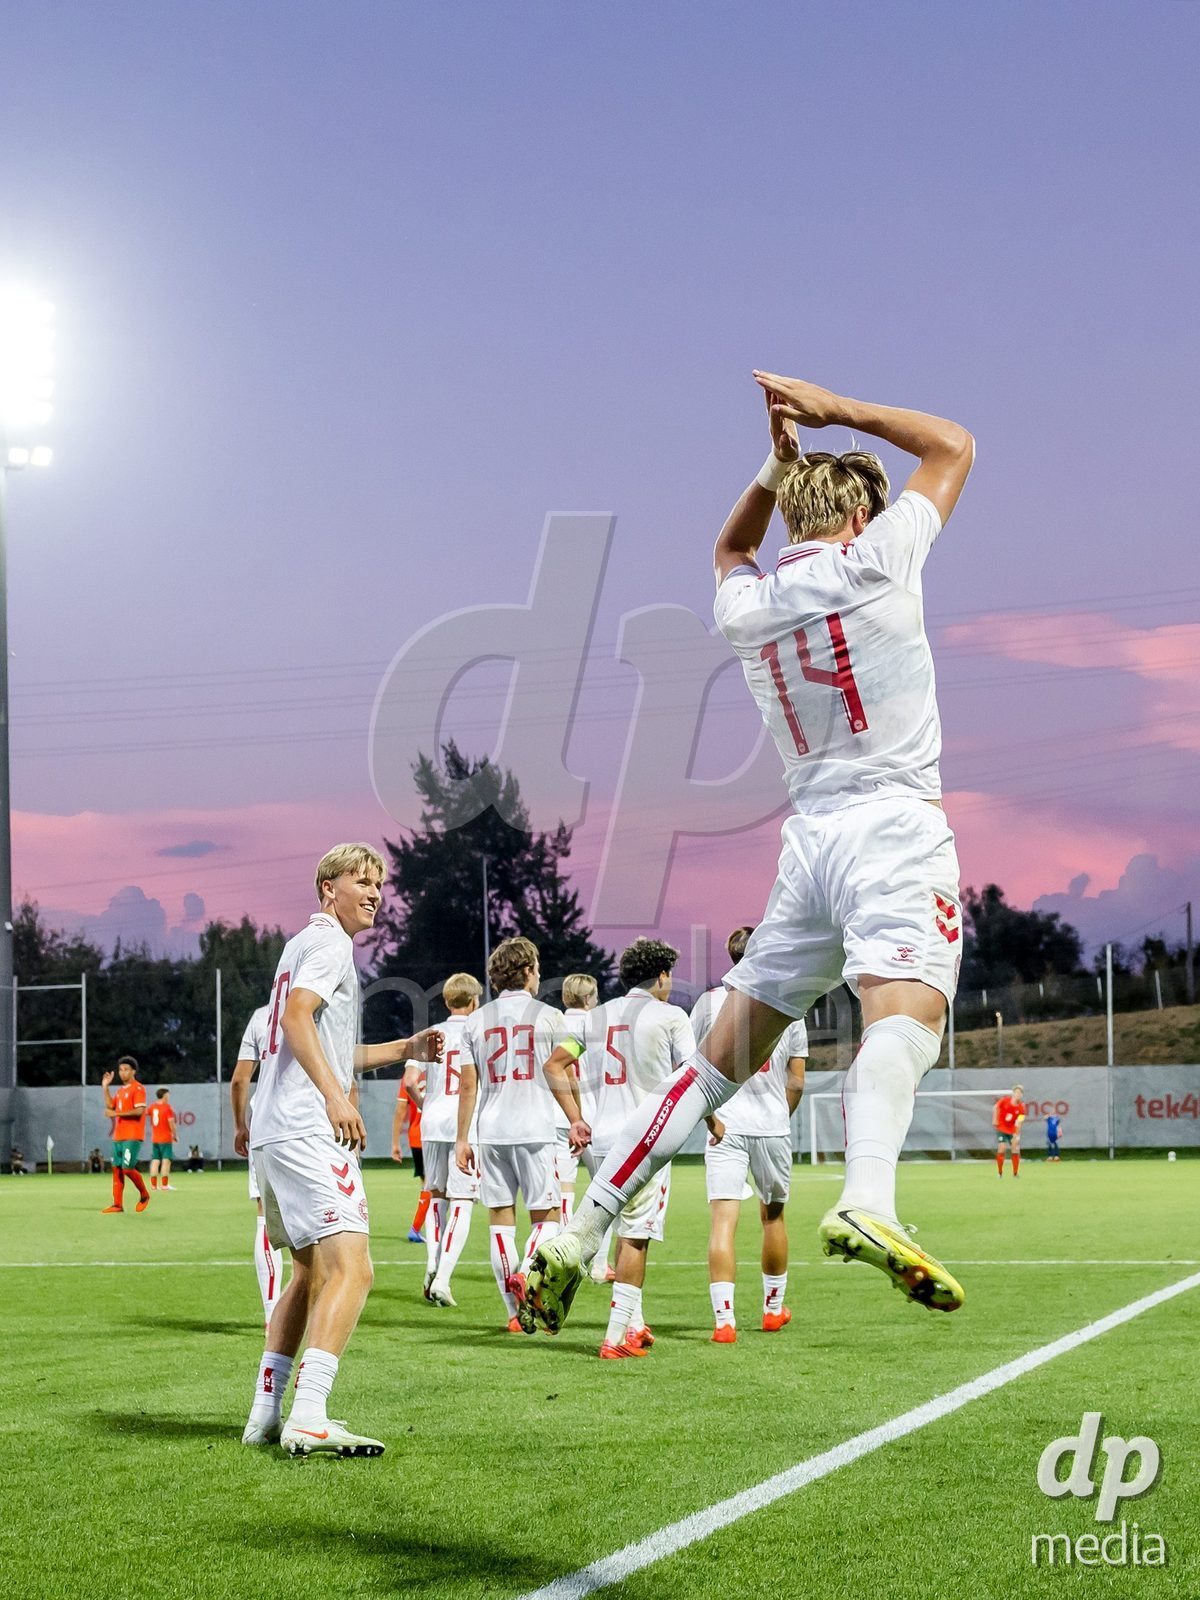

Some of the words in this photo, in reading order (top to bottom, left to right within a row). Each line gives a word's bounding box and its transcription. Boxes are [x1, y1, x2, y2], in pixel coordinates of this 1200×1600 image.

[760, 612, 869, 757] 14
[484, 1024, 535, 1084] 23
[604, 1024, 630, 1086] 5
[644, 1098, 674, 1147] DANMARK
[1023, 1100, 1070, 1116] nco
[1134, 1092, 1200, 1119] tek4
